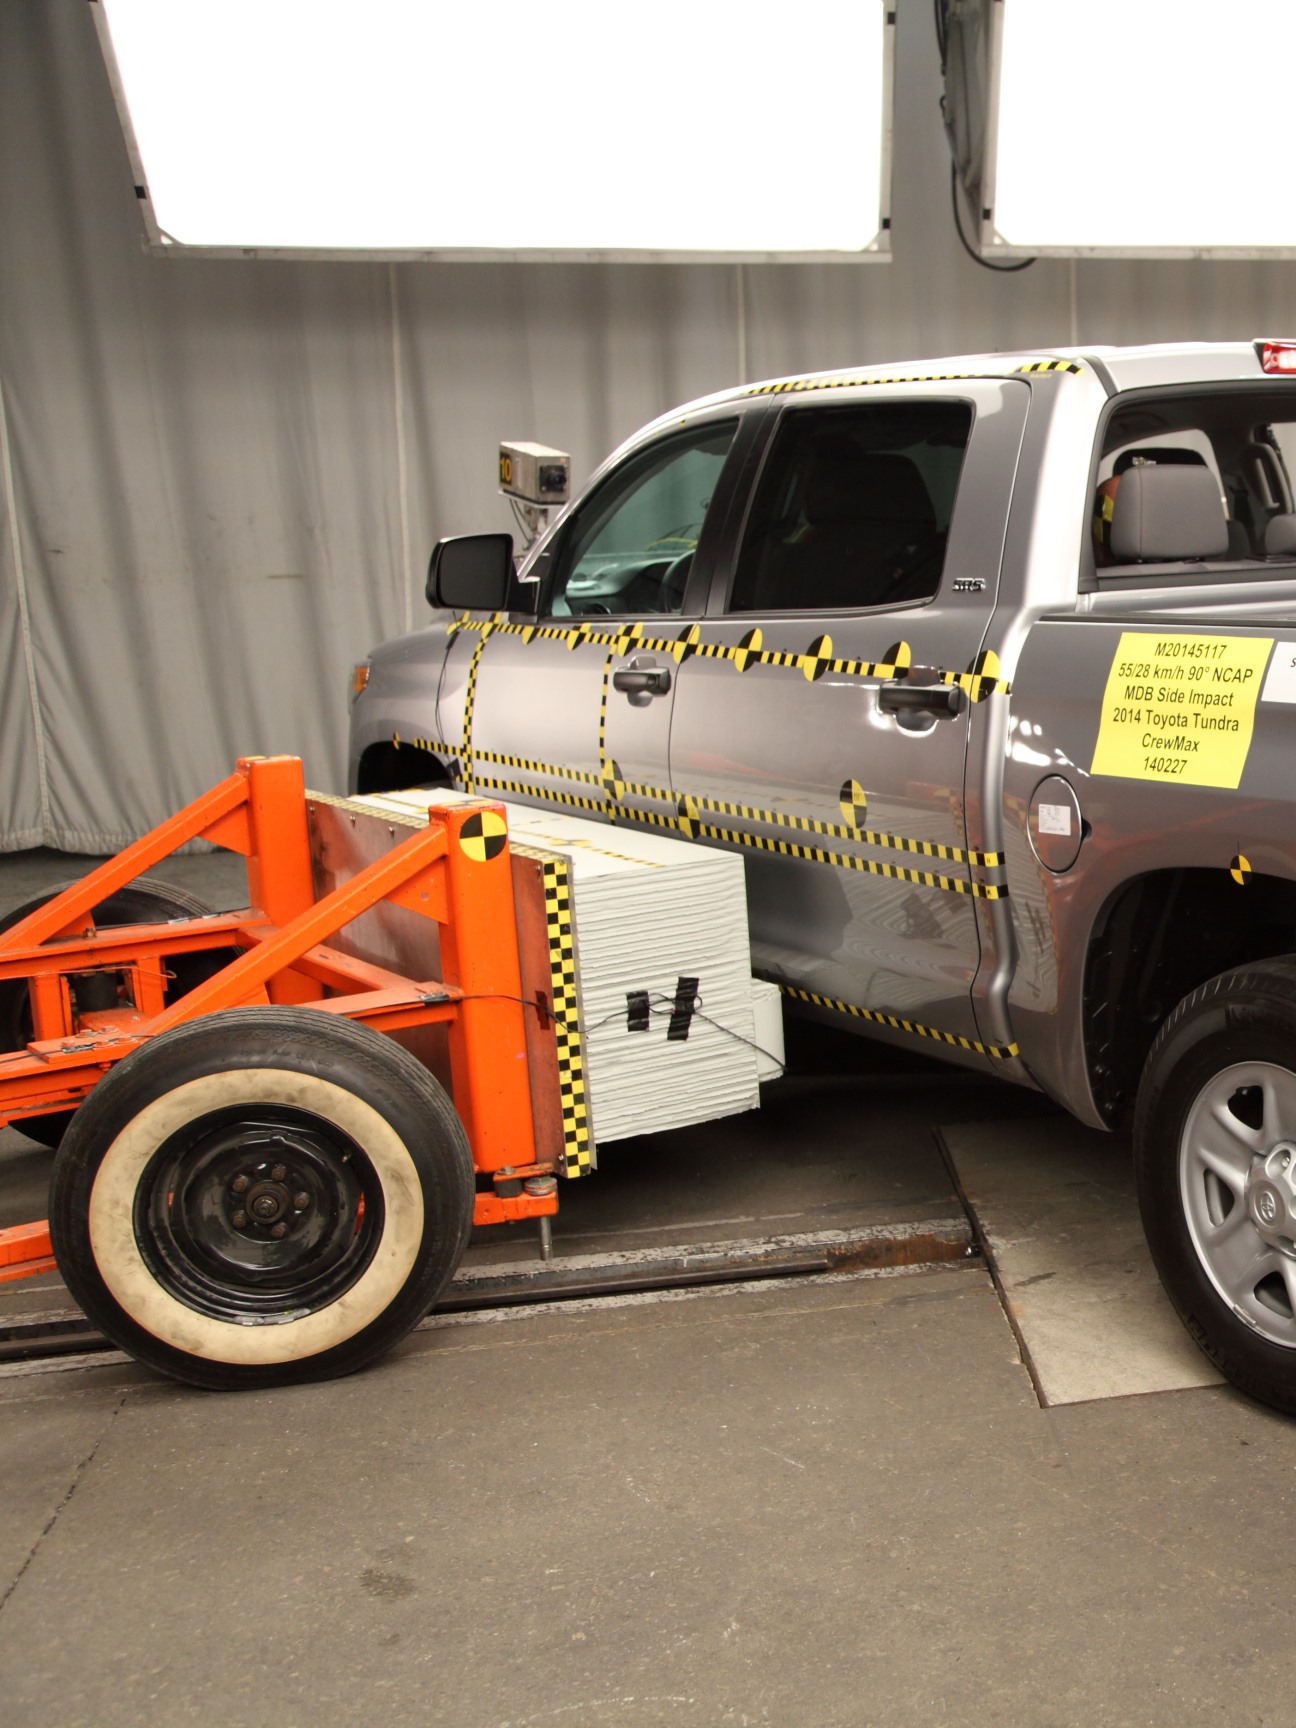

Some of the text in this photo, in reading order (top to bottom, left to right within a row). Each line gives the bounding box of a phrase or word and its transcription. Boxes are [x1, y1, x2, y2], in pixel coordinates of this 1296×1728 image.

[1154, 642, 1227, 660] M20145117
[1118, 663, 1150, 679] 55/28
[1153, 664, 1184, 681] km/h
[1212, 667, 1253, 684] NCAP
[1124, 685, 1234, 708] MDB Side Impact
[1113, 707, 1239, 732] 2014 Toyota Tundra
[1141, 733, 1200, 753] CrewMax
[1143, 757, 1187, 775] 140227
